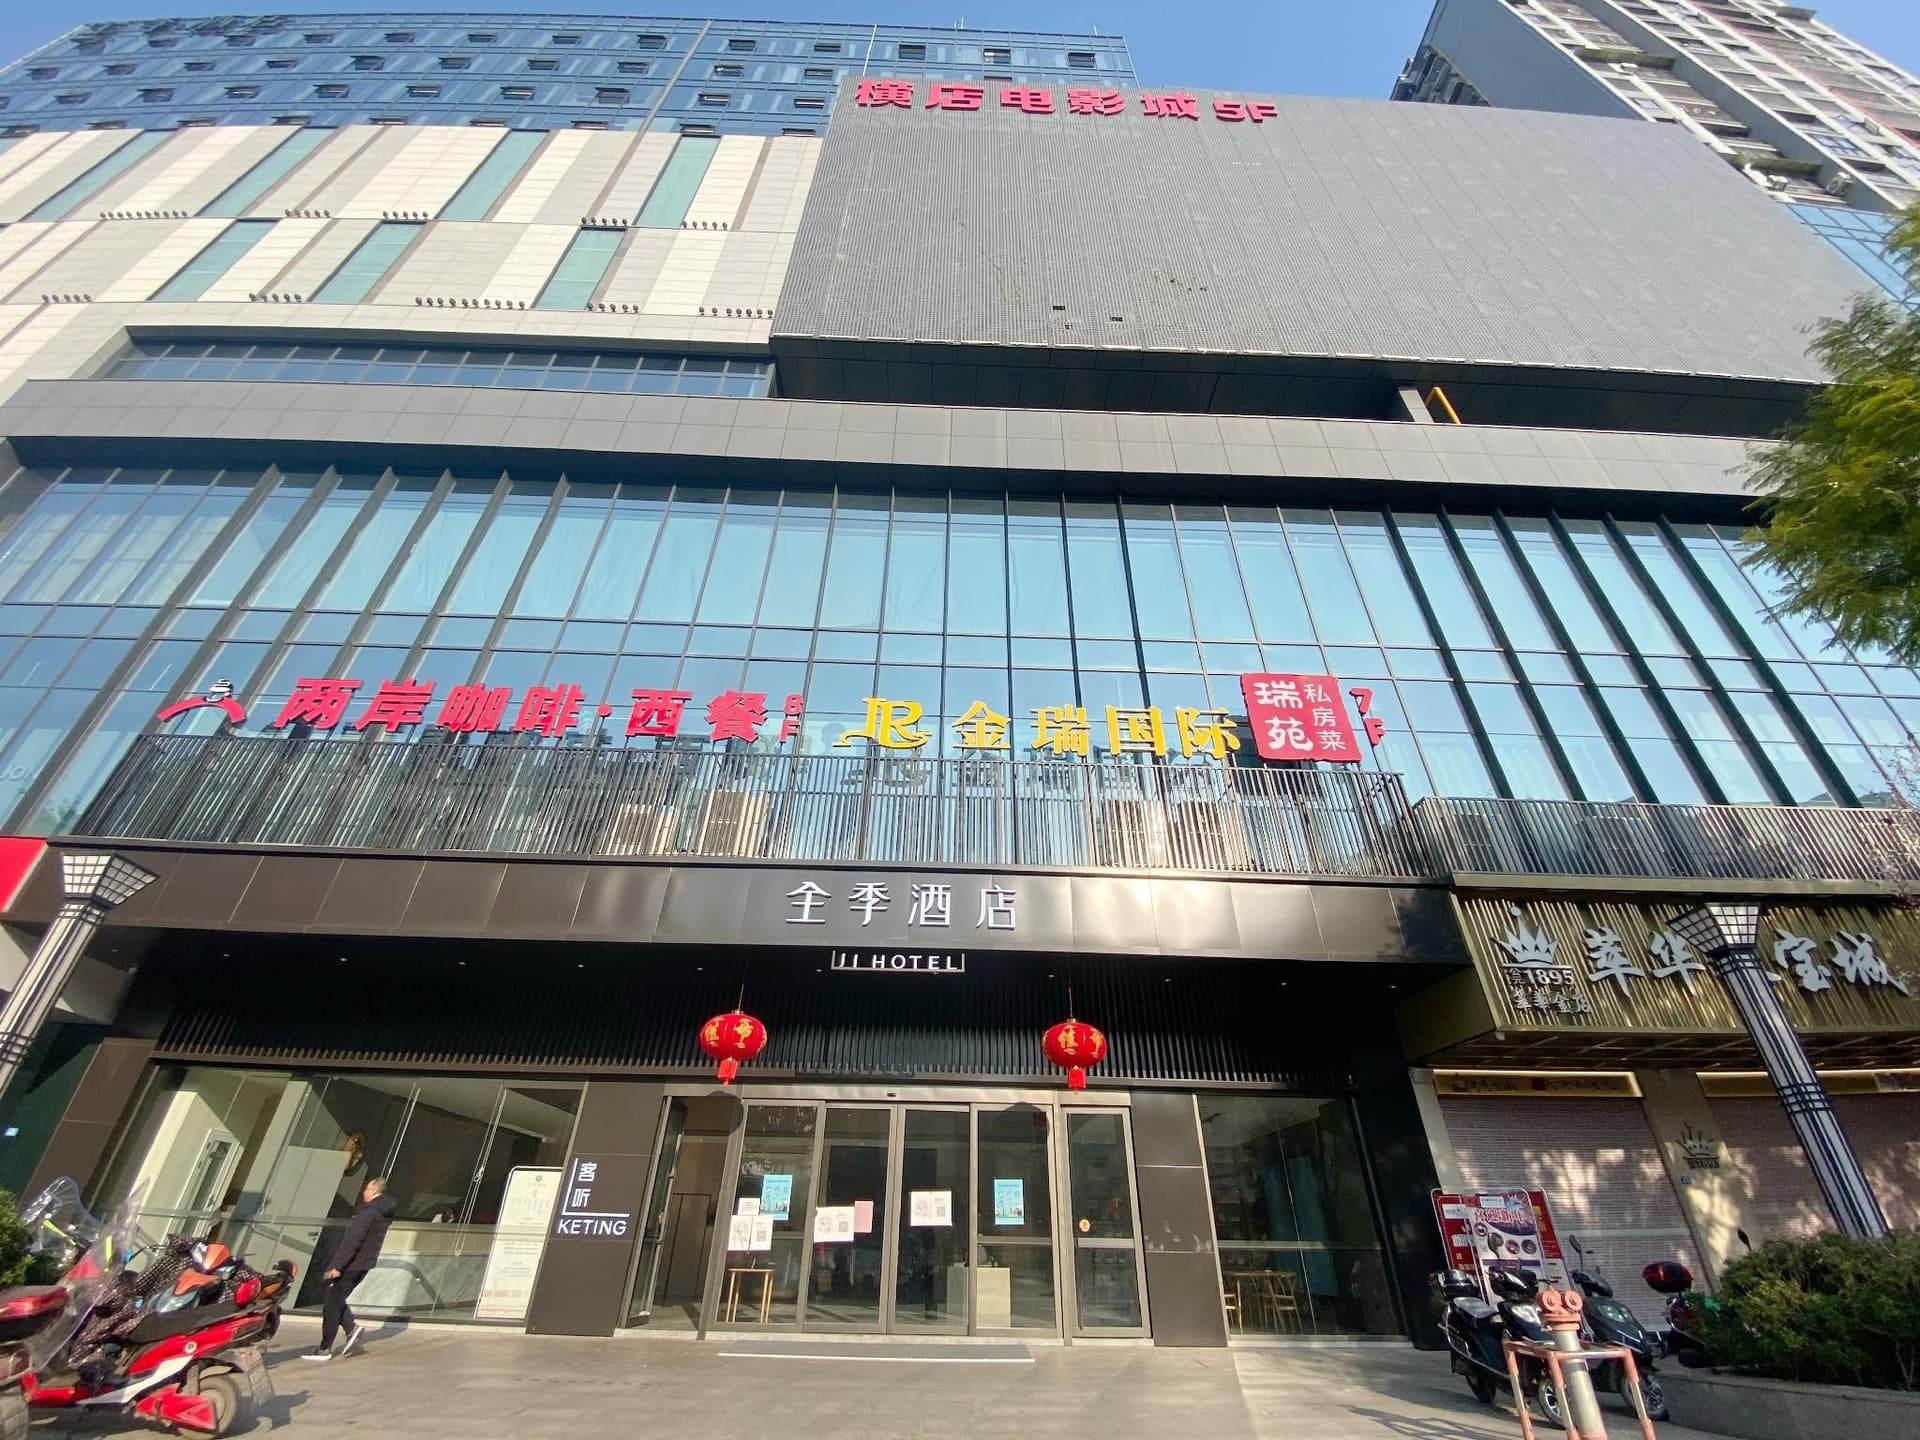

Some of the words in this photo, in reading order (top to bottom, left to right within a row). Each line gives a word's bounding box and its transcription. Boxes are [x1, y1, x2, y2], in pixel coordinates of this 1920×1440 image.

[855, 79, 1201, 120] 横店电影城
[1213, 100, 1279, 123] 5F
[952, 700, 1241, 761] 金瑞国际
[1253, 680, 1315, 753] 瑞苑
[1302, 682, 1348, 752] 私房菜
[1348, 687, 1388, 746] 7F
[785, 881, 1018, 931] 全季酒店
[838, 952, 859, 969] JI
[871, 953, 959, 971] HOTEL
[1523, 969, 1576, 986] 1895
[1584, 926, 1911, 998] 萃华宝城
[571, 1161, 598, 1209] 客听
[556, 1219, 628, 1237] KETING
